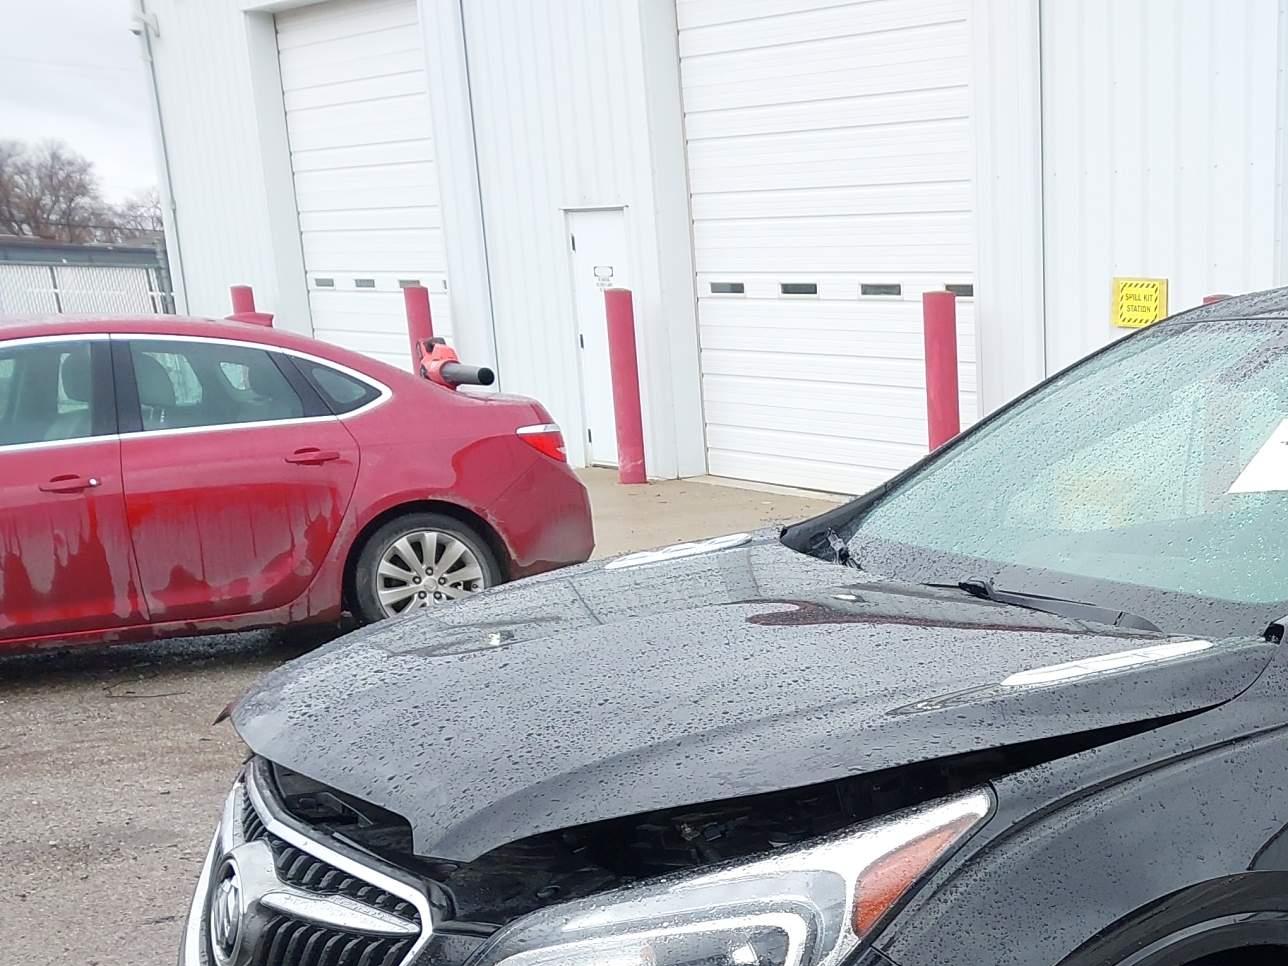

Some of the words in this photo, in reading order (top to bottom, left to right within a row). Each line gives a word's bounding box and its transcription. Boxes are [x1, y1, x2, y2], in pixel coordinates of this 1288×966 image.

[1125, 293, 1142, 302] SPILL
[1143, 293, 1154, 302] KIT
[1126, 304, 1151, 313] STATION
